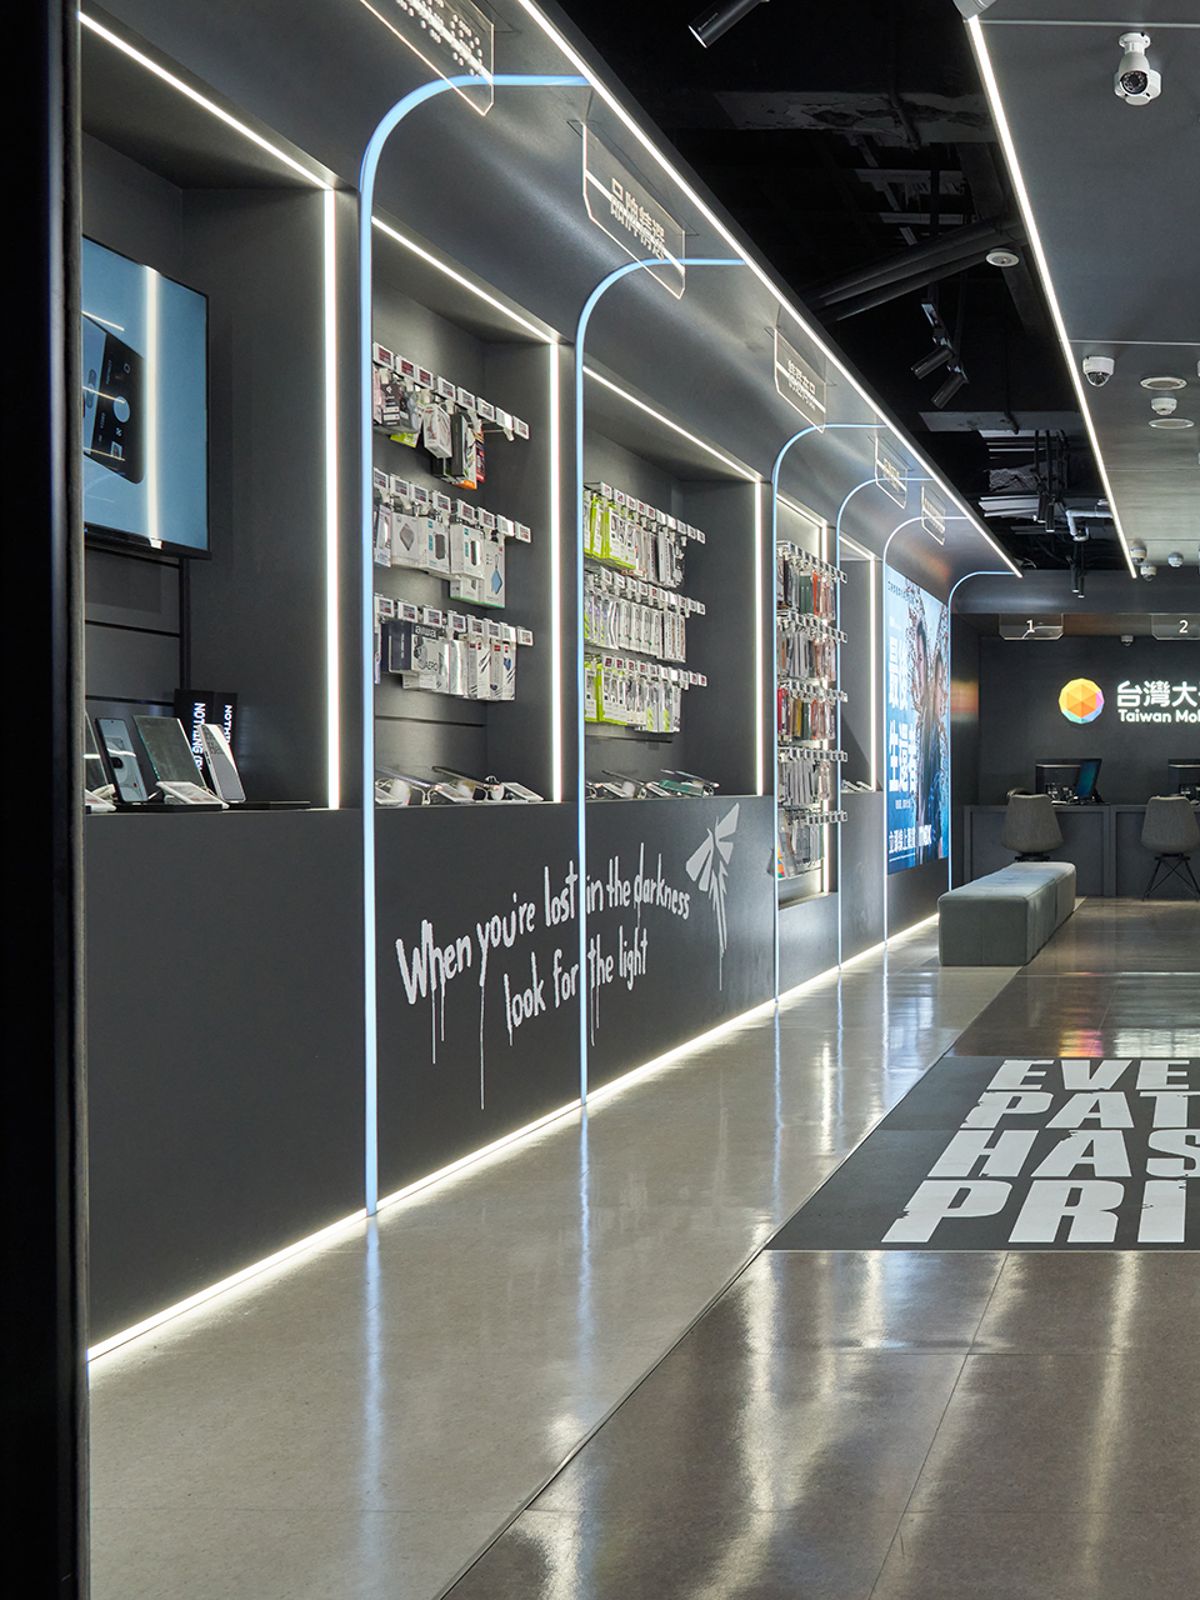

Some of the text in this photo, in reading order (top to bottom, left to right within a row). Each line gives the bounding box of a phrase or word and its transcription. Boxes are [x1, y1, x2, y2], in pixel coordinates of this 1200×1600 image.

[1026, 620, 1035, 633] 1
[1178, 620, 1188, 634] 2
[1118, 708, 1172, 723] Taiwan
[395, 842, 691, 1004] When you're lost in the darkness
[504, 925, 649, 1028] look for the light
